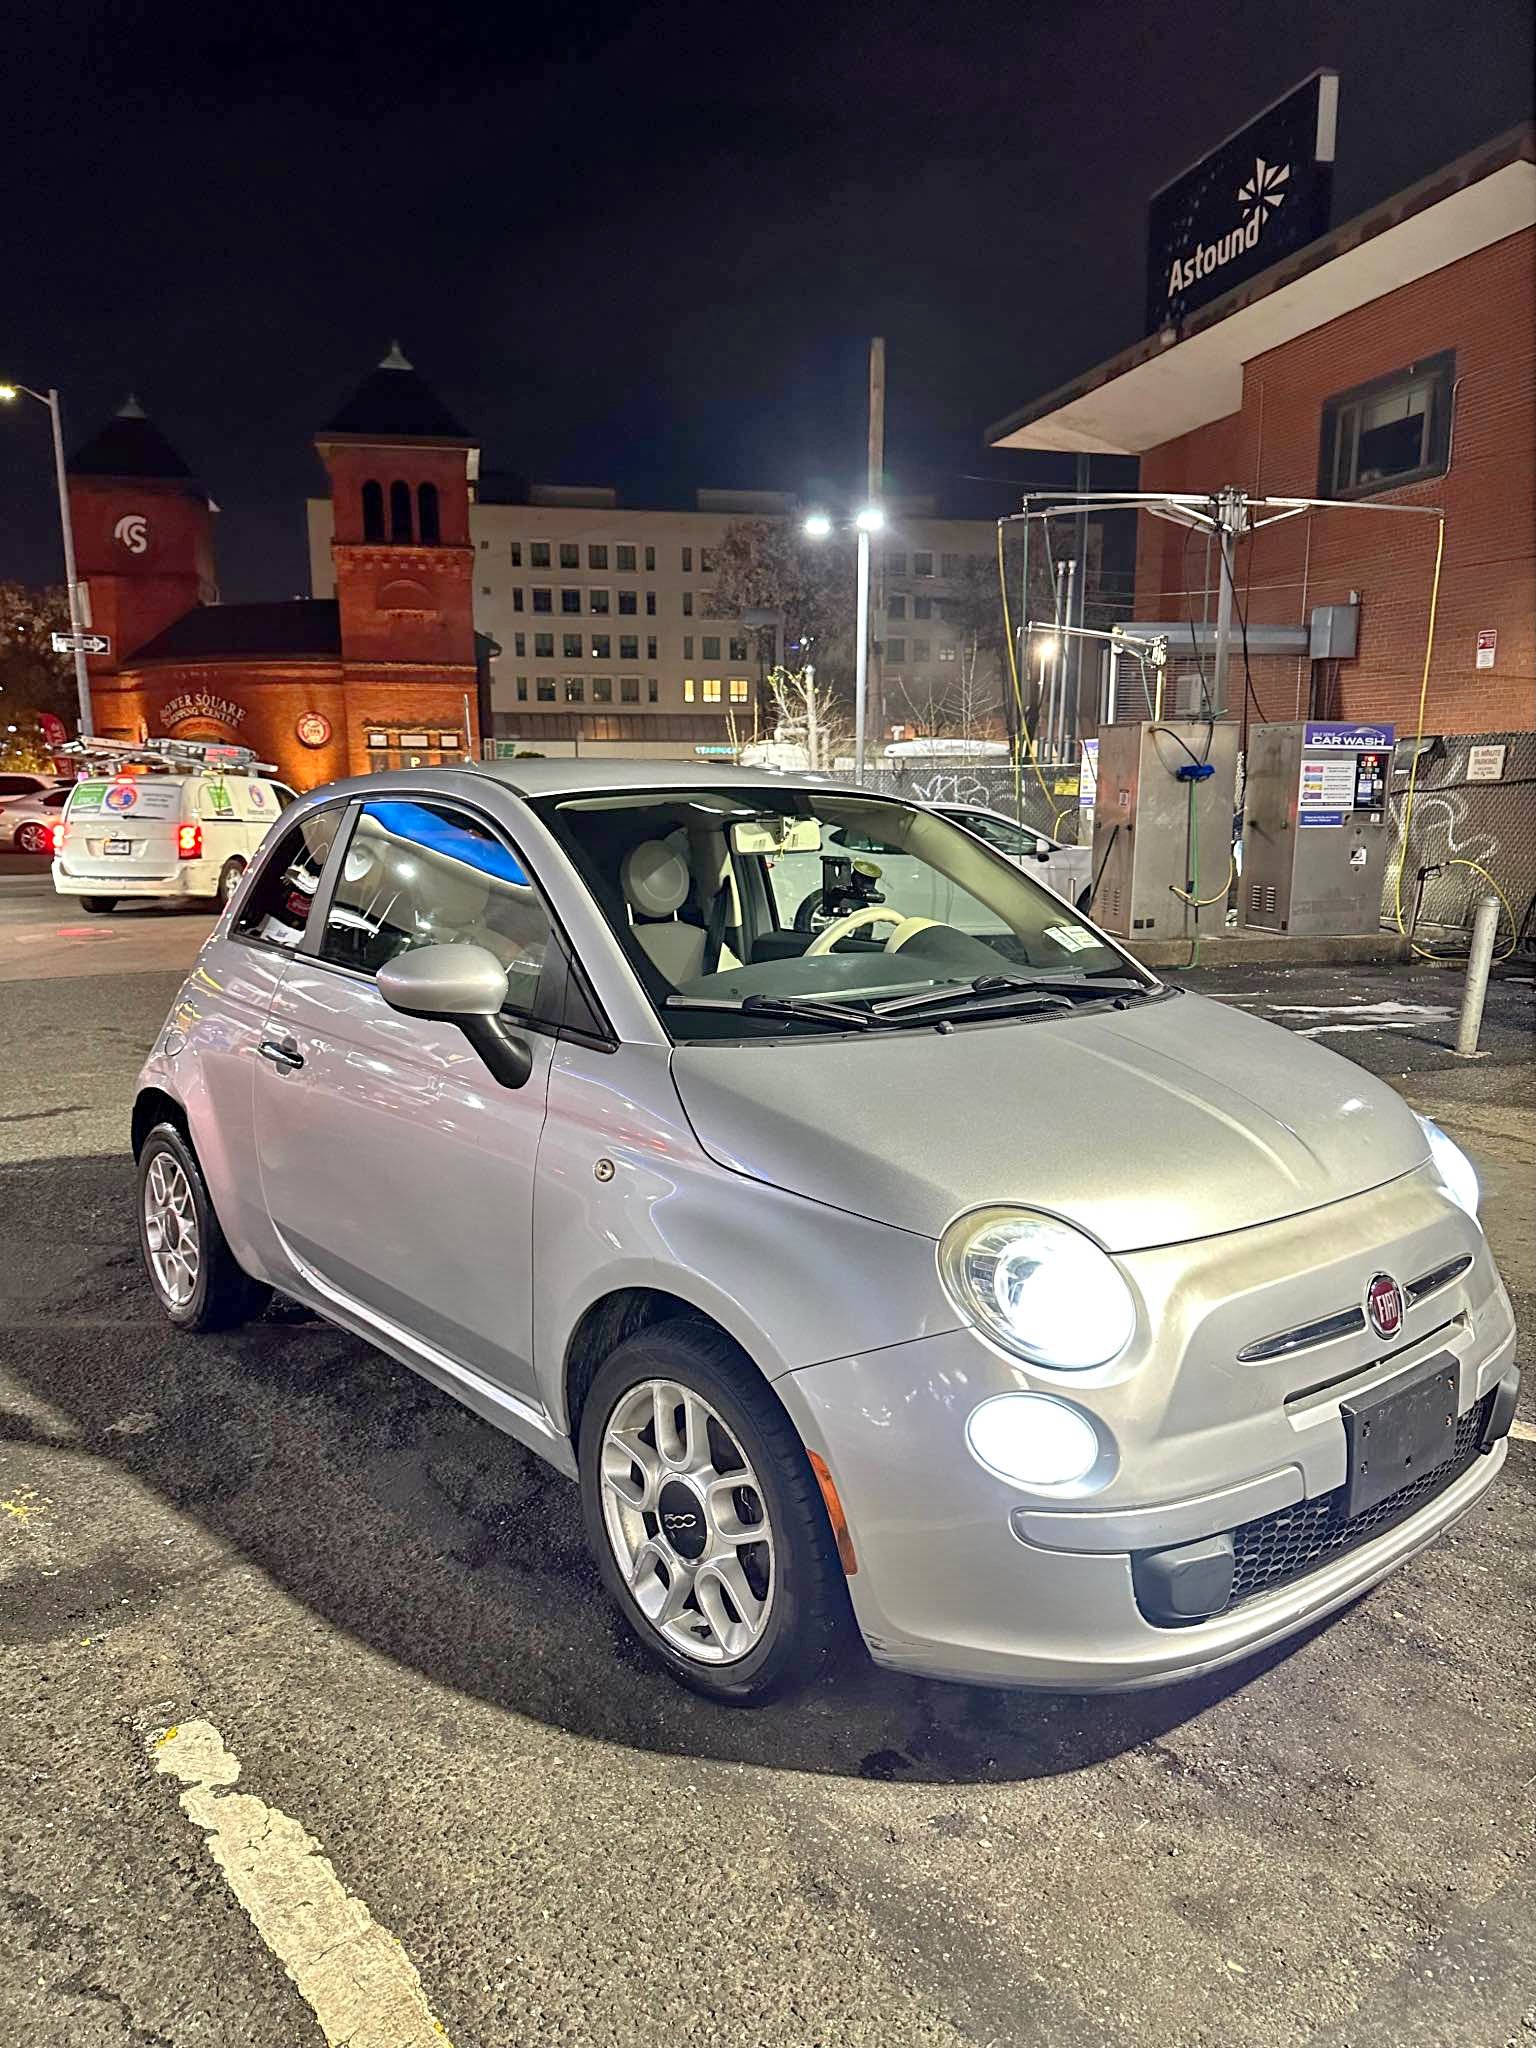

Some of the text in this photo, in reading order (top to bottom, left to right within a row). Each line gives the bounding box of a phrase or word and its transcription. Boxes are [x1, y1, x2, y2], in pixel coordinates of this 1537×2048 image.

[1168, 205, 1261, 298] Astound
[195, 694, 246, 721] SQUARE
[202, 707, 239, 728] CENTER
[1312, 736, 1385, 746] CAR WASH
[1376, 1290, 1400, 1322] FIAT
